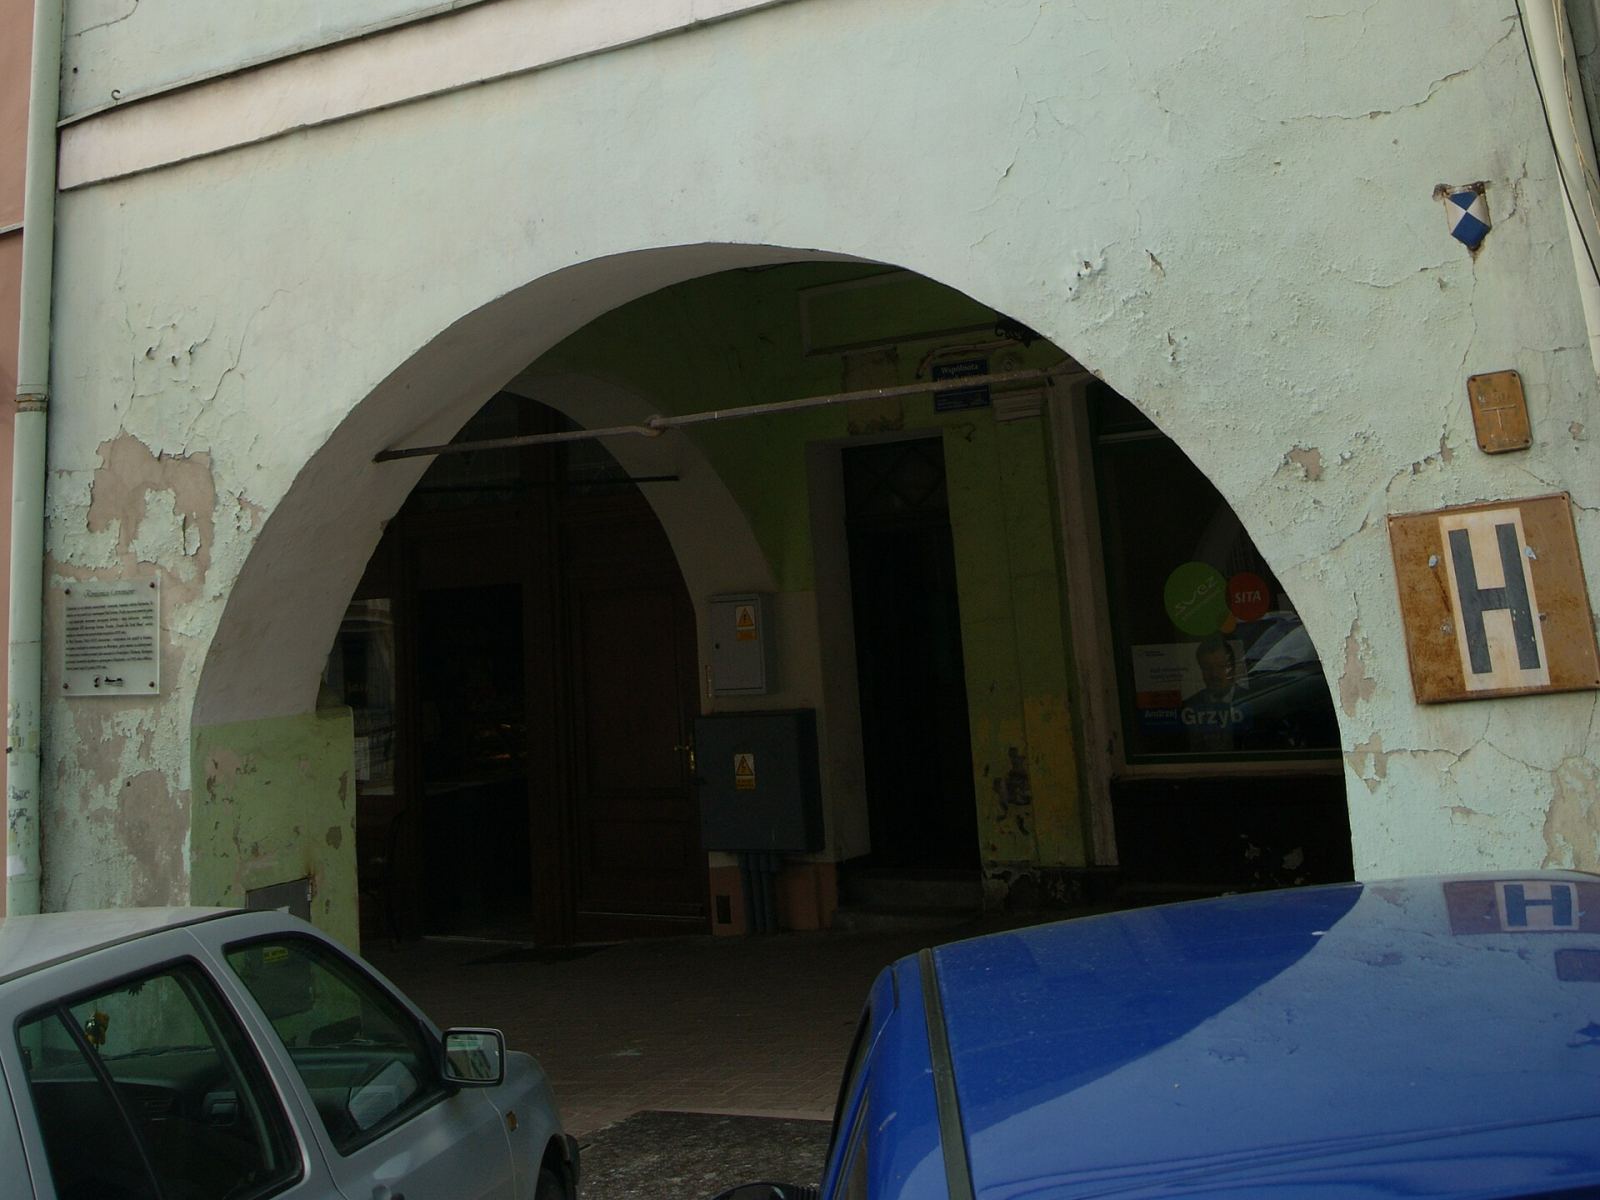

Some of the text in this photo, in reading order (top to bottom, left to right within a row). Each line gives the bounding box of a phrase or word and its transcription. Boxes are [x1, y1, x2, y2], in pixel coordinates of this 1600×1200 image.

[1234, 590, 1262, 605] SITA
[1448, 522, 1541, 675] H
[1182, 706, 1243, 728] Grzyb
